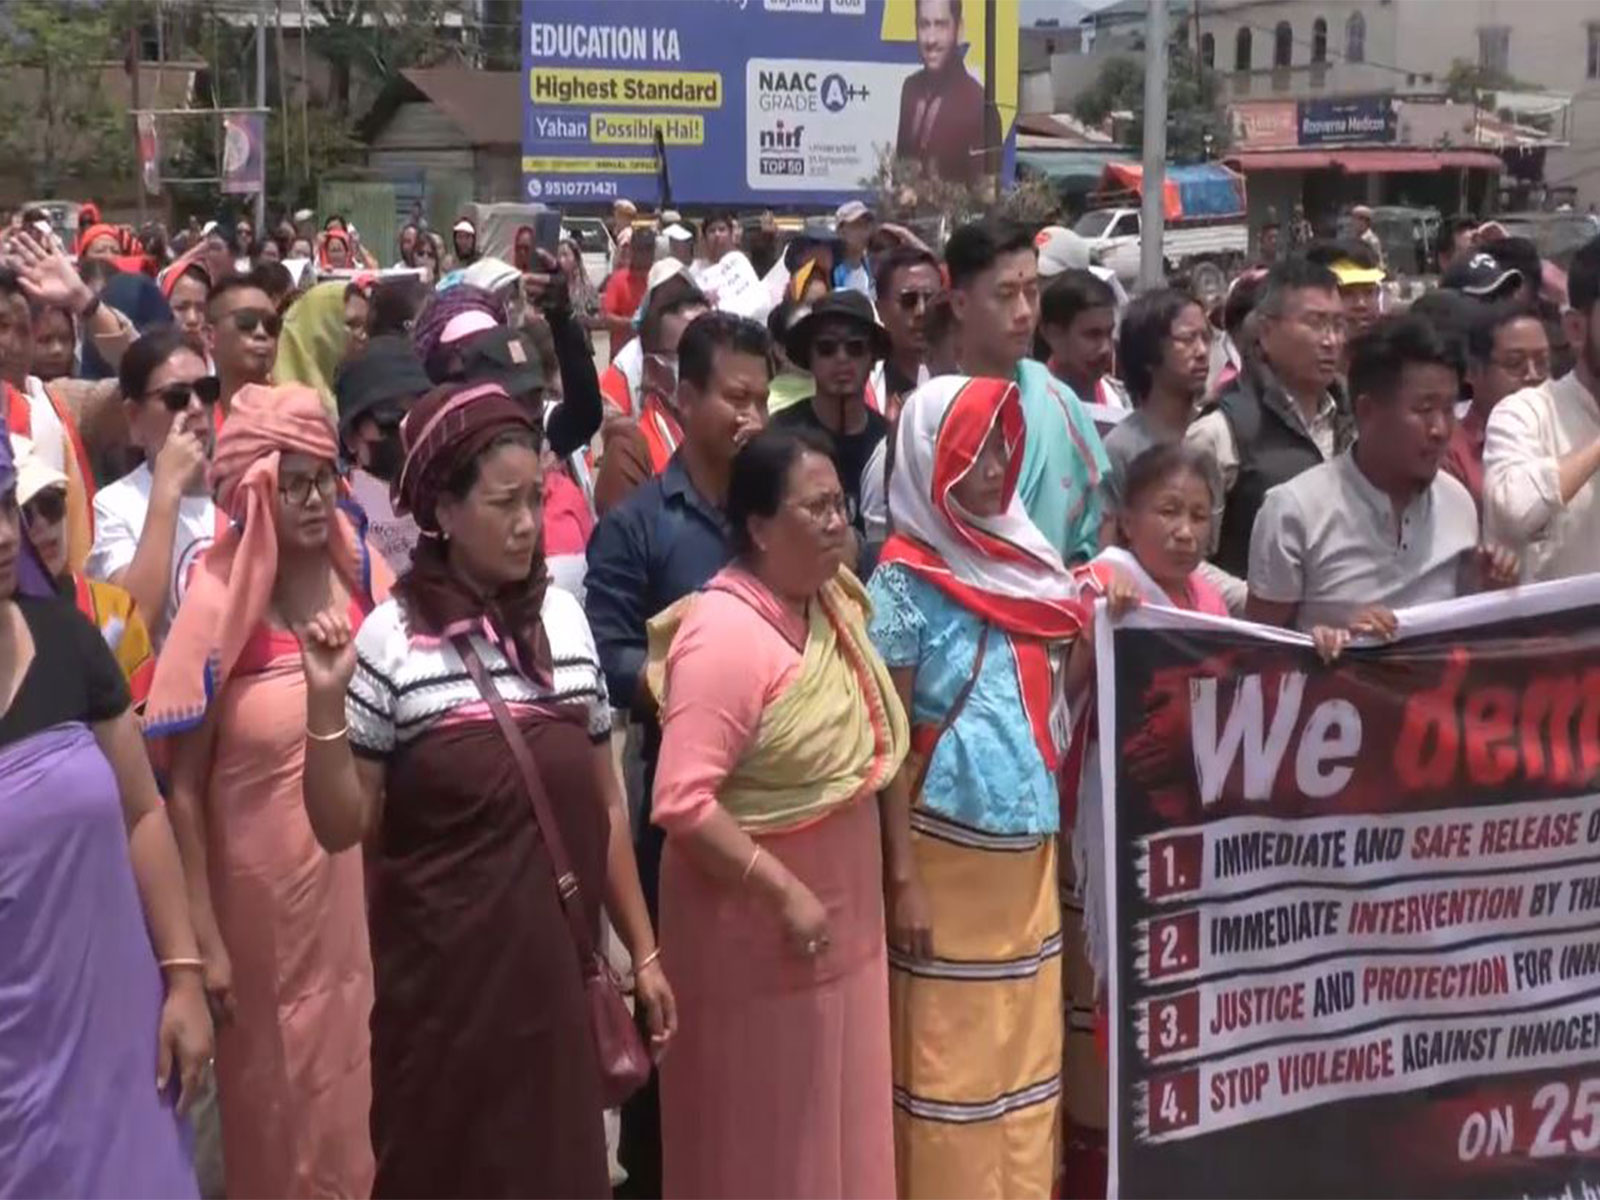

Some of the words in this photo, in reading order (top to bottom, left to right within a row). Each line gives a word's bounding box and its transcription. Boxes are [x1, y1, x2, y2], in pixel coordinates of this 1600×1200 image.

[530, 22, 648, 60] EDUCATION
[652, 27, 681, 61] KA
[535, 75, 618, 101] Highest
[623, 78, 717, 101] Standard
[760, 71, 817, 92] NAAC
[760, 94, 817, 112] GRADE
[536, 117, 587, 137] Yahan
[666, 119, 700, 139] Hai!
[760, 120, 804, 147] nirf
[763, 159, 787, 173] TOP
[1190, 673, 1362, 808] We
[1163, 846, 1186, 887] 1.
[1214, 829, 1346, 878] IMMEDIATE
[1353, 827, 1405, 867] AND
[1411, 822, 1473, 860] SAFE
[1479, 811, 1582, 855] RELEASE
[1160, 925, 1187, 968] 2.
[1210, 902, 1343, 956] IMMEDIATE
[1348, 885, 1524, 935] INTERVENTION
[1529, 881, 1563, 917] BY
[1160, 1005, 1187, 1048] 3.
[1210, 983, 1305, 1035] JUSTICE
[1313, 971, 1354, 1018] AND
[1362, 955, 1509, 1006] PROTECTION
[1513, 947, 1553, 991] FOR
[1160, 1082, 1187, 1123] 4.
[1210, 1061, 1270, 1113] STOP
[1278, 1038, 1394, 1096] VIOLENCE
[1402, 1027, 1503, 1074] AGAINST
[1458, 1104, 1514, 1162] ON
